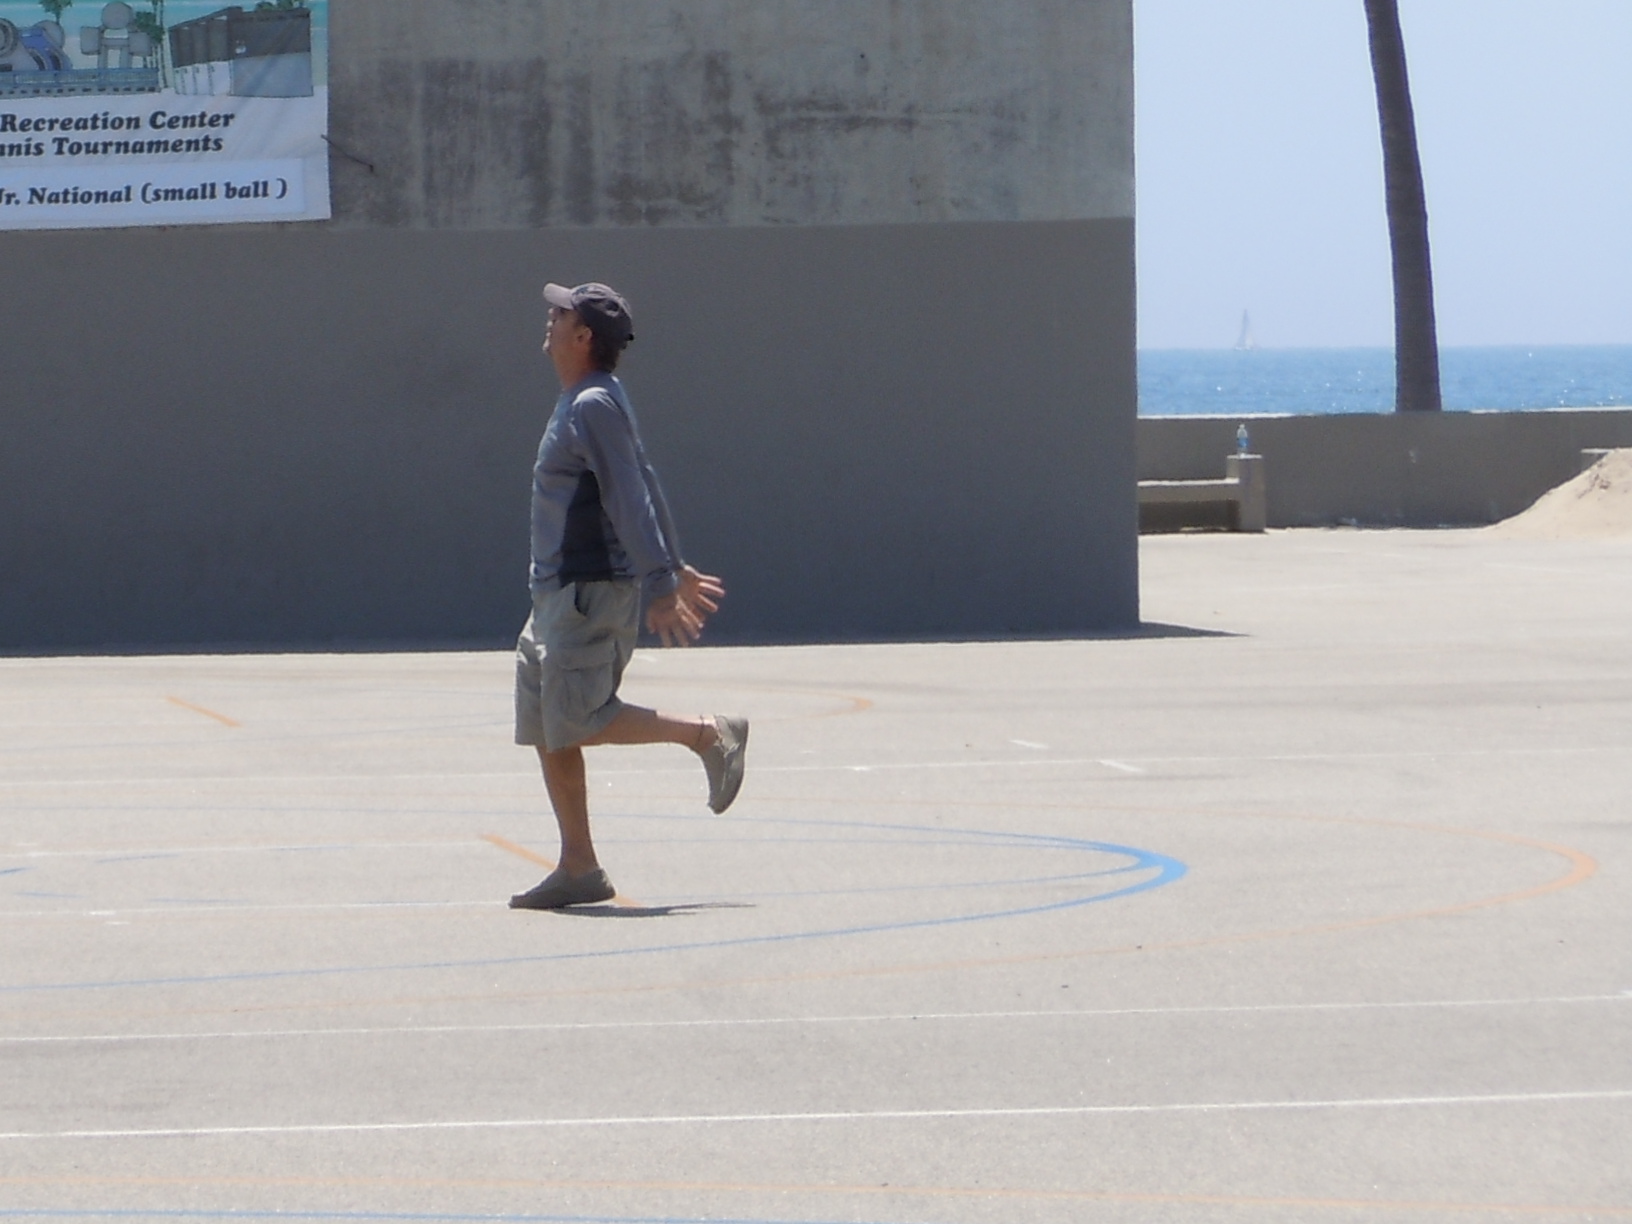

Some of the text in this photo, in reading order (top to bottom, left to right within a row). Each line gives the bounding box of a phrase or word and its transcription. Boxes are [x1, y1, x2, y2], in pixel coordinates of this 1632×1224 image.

[0, 112, 140, 133] Recreation
[148, 110, 235, 130] Center
[52, 133, 225, 156] Tournaments
[27, 184, 133, 206] National
[140, 180, 218, 206] (small
[224, 180, 269, 200] ball
